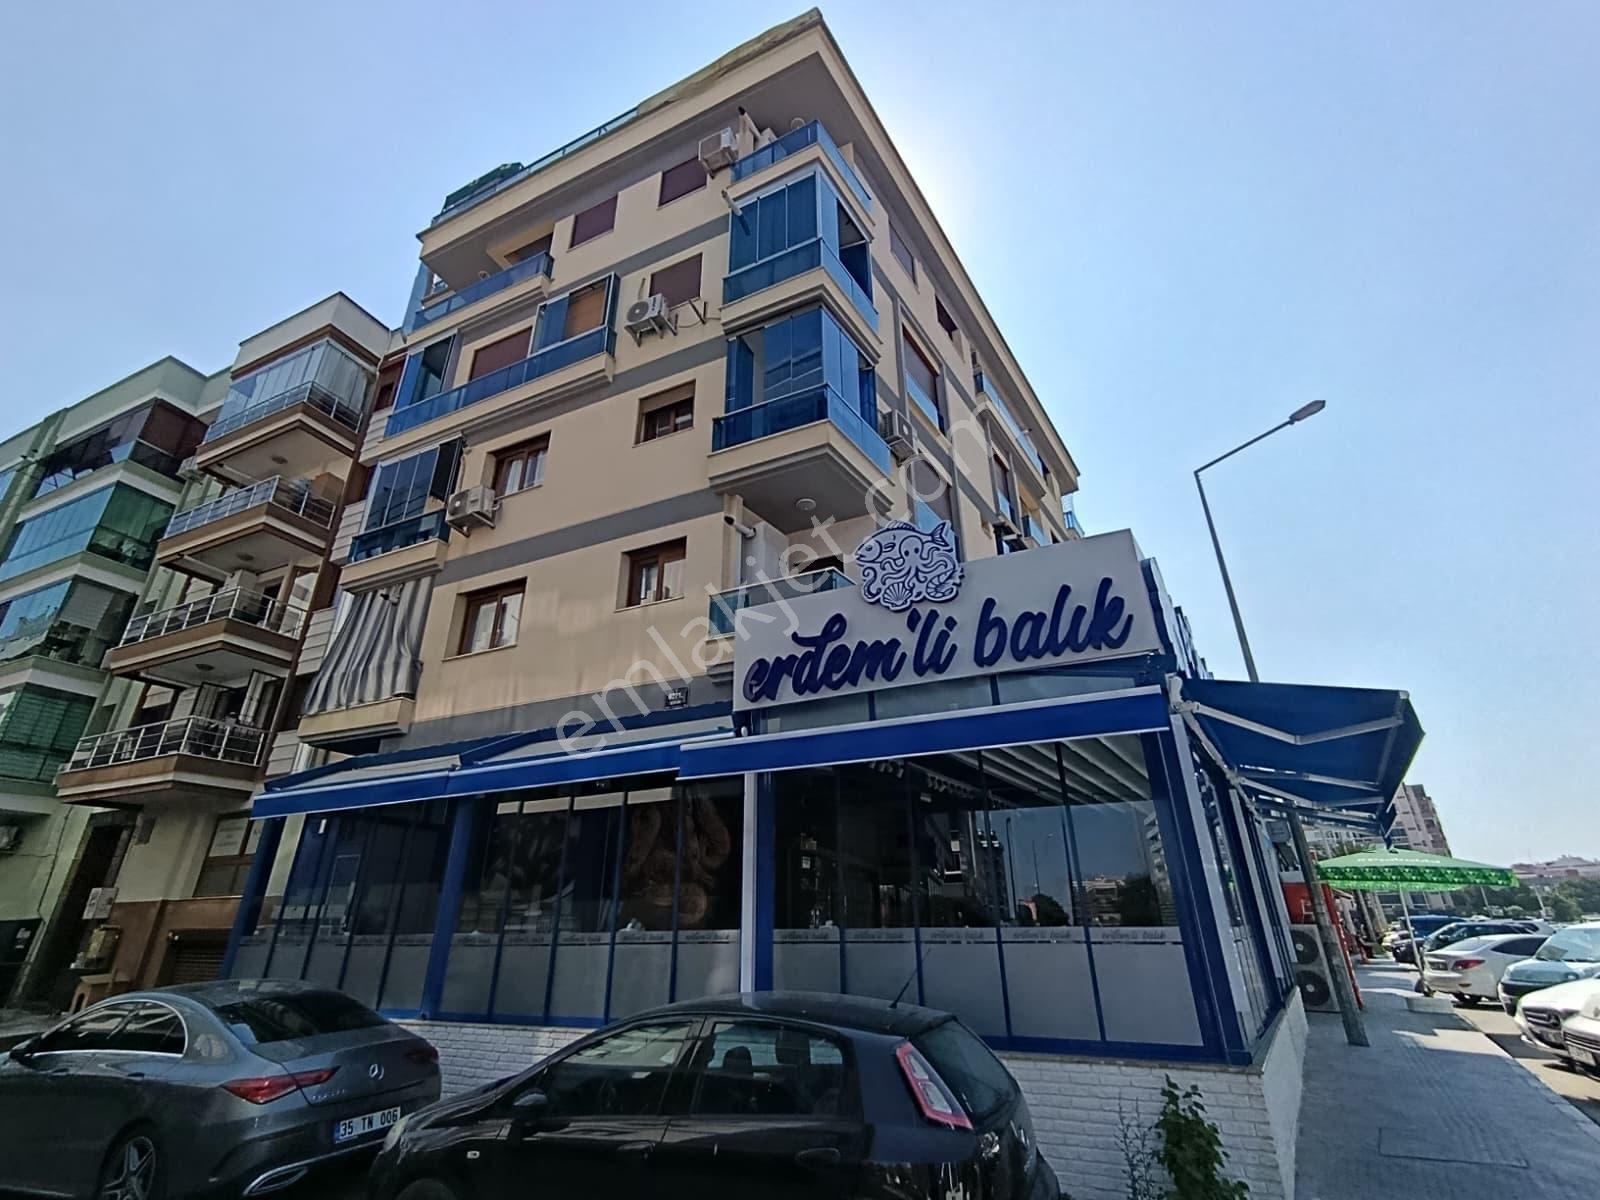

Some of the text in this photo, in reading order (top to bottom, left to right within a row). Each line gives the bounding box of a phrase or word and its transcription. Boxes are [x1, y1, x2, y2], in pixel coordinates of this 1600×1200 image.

[743, 577, 1134, 702] erdem'li balık
[340, 1109, 398, 1137] 35 TN 006
